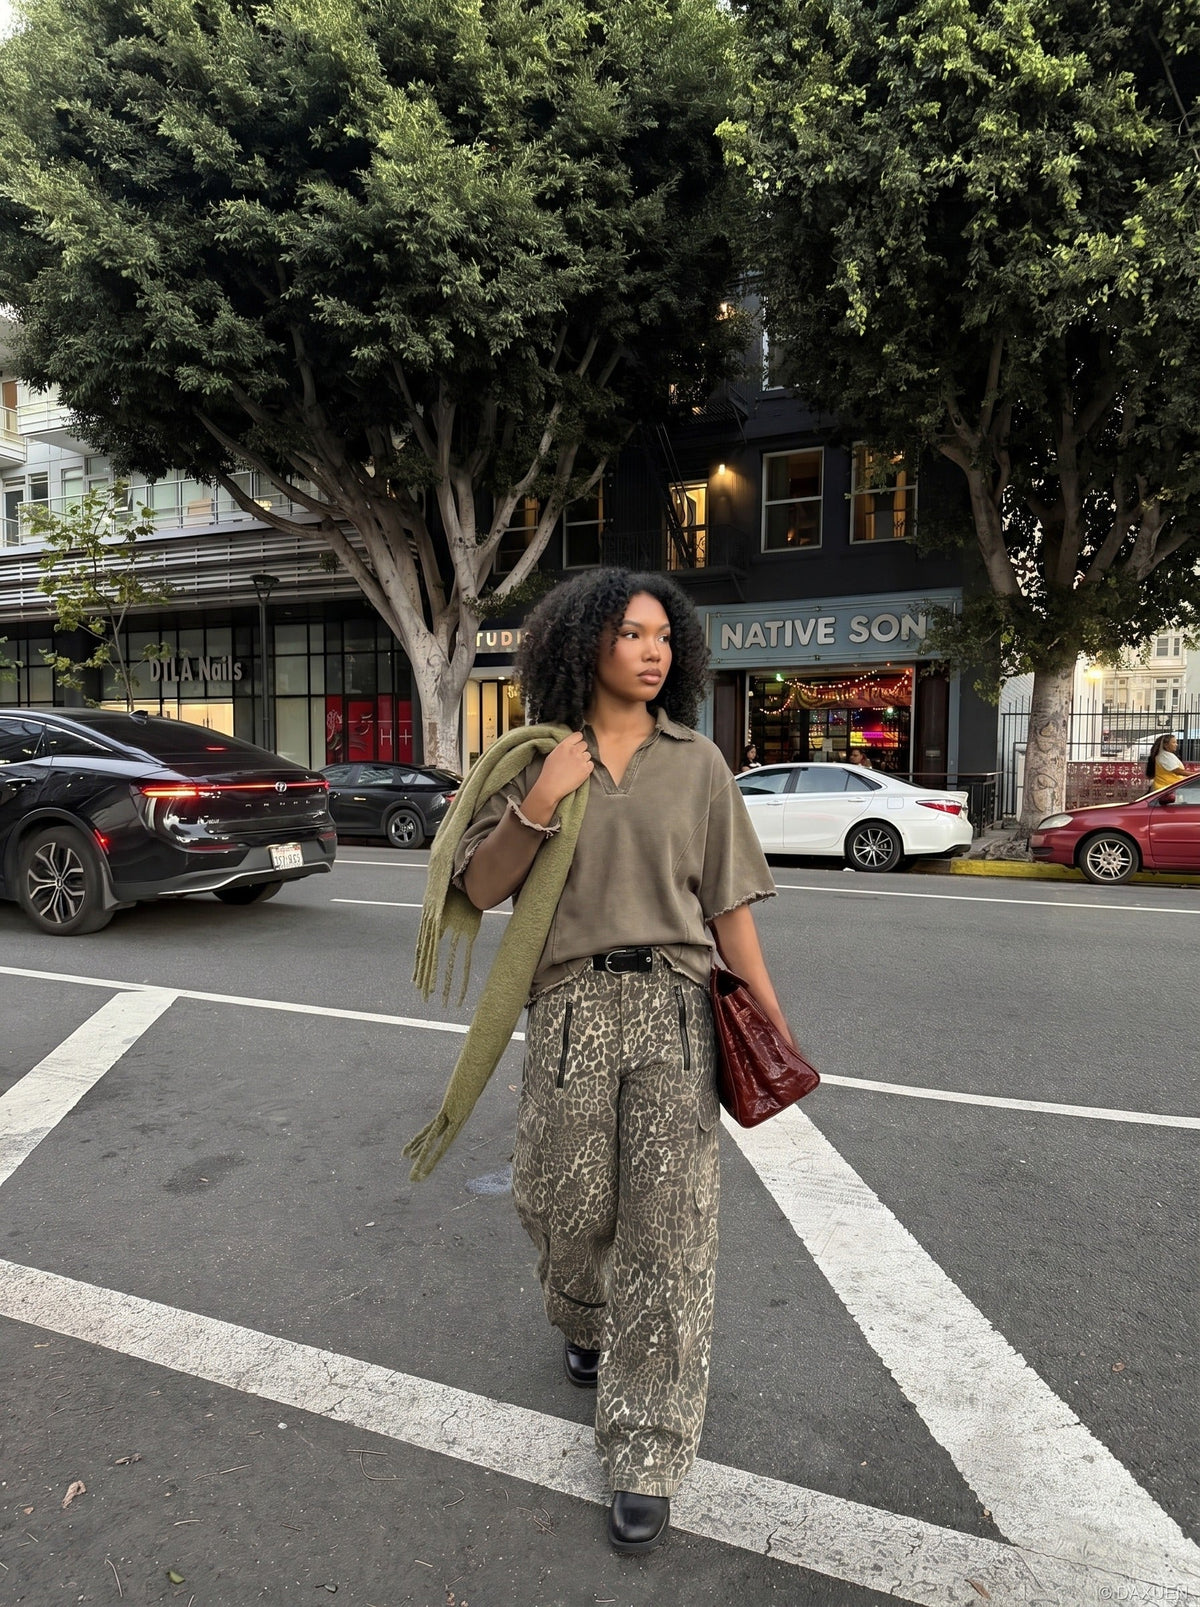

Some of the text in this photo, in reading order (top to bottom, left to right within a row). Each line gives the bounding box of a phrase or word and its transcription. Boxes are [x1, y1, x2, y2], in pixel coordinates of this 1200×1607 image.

[475, 631, 522, 647] TUDI
[721, 613, 926, 650] NATIVE SON
[149, 656, 242, 681] DTLA Nails
